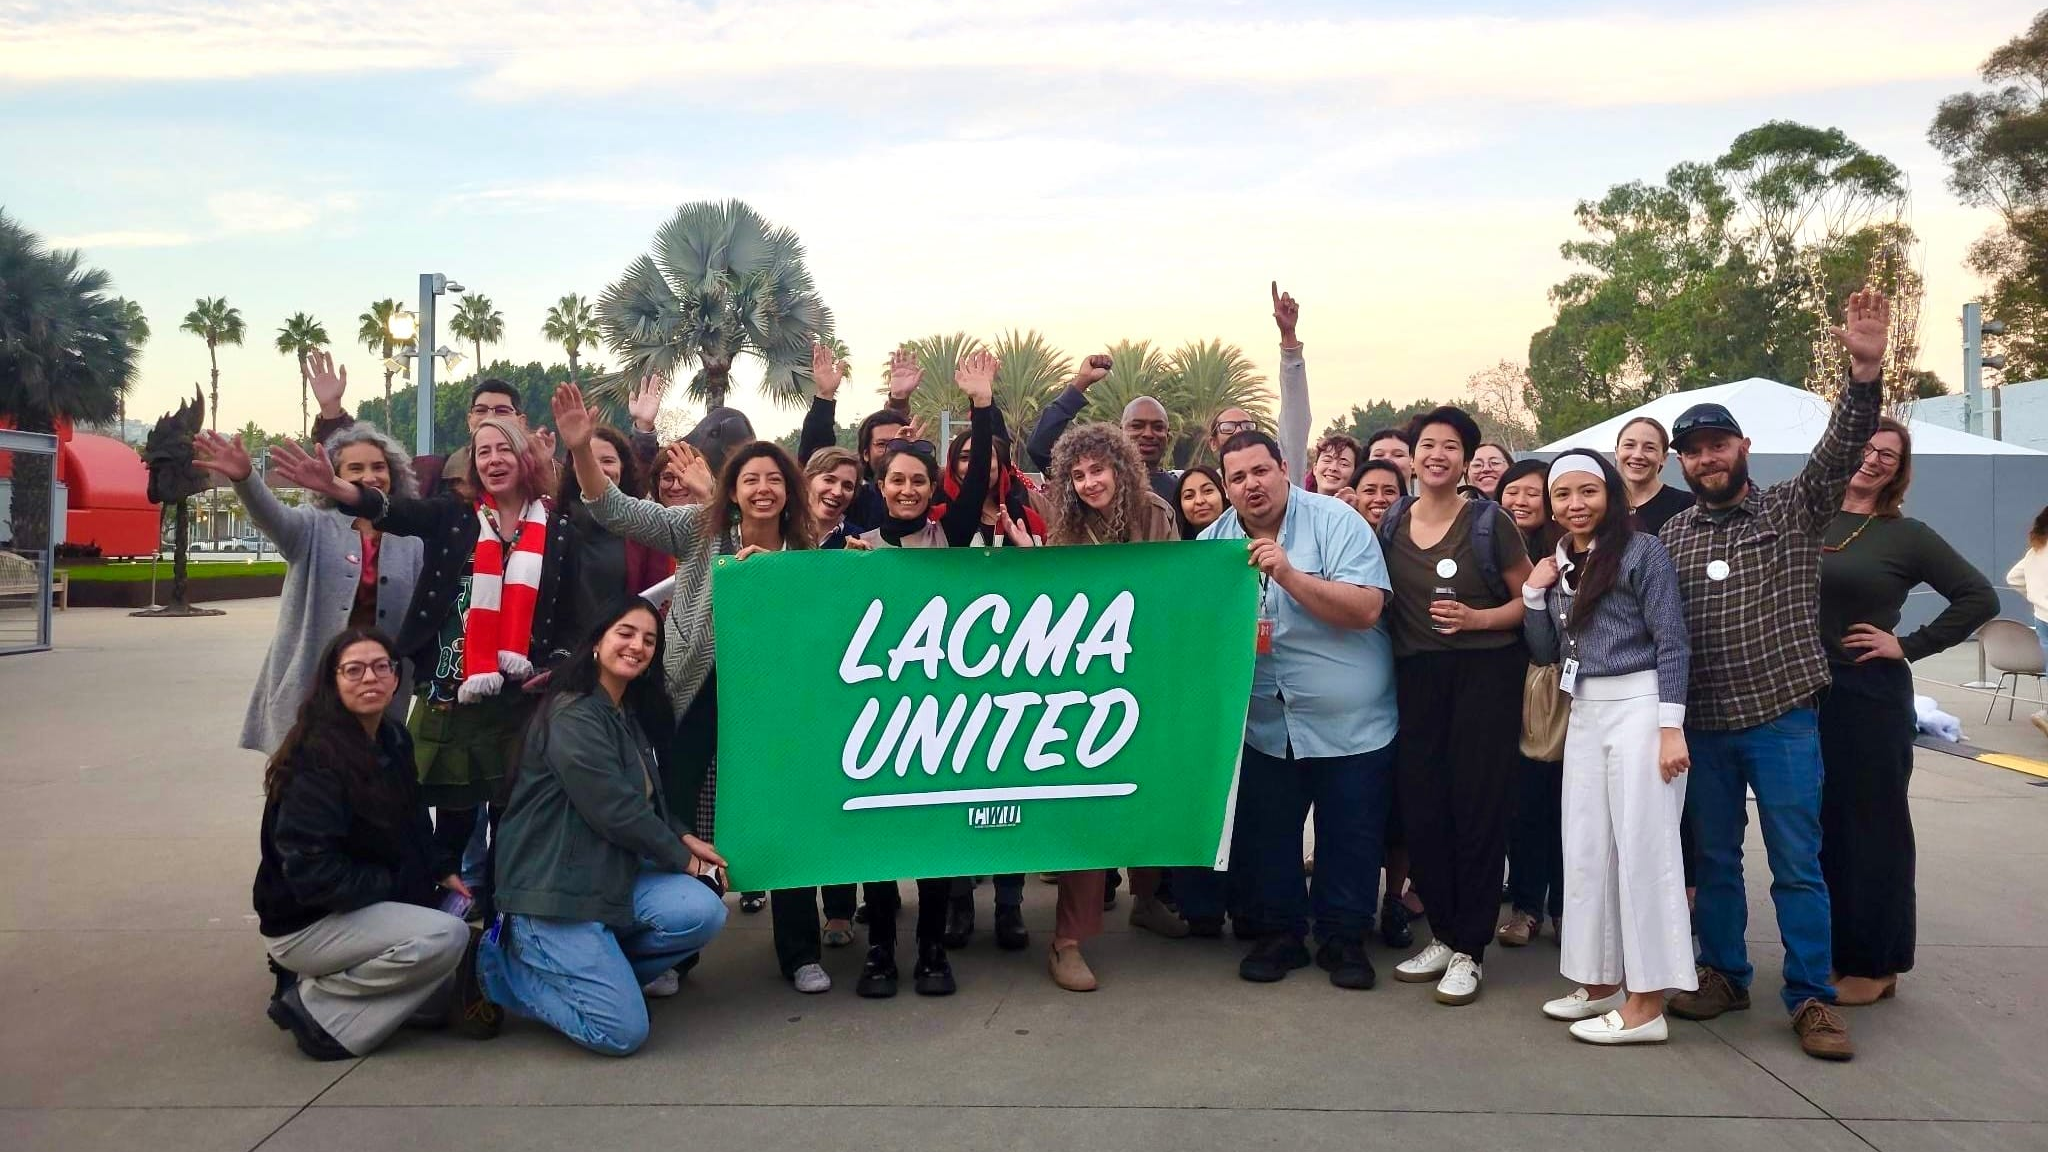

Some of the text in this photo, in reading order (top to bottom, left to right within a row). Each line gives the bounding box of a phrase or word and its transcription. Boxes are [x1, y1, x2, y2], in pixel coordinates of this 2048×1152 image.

[839, 591, 1134, 683] LACMA
[842, 688, 1139, 779] UNITED
[969, 806, 1021, 825] CWU
